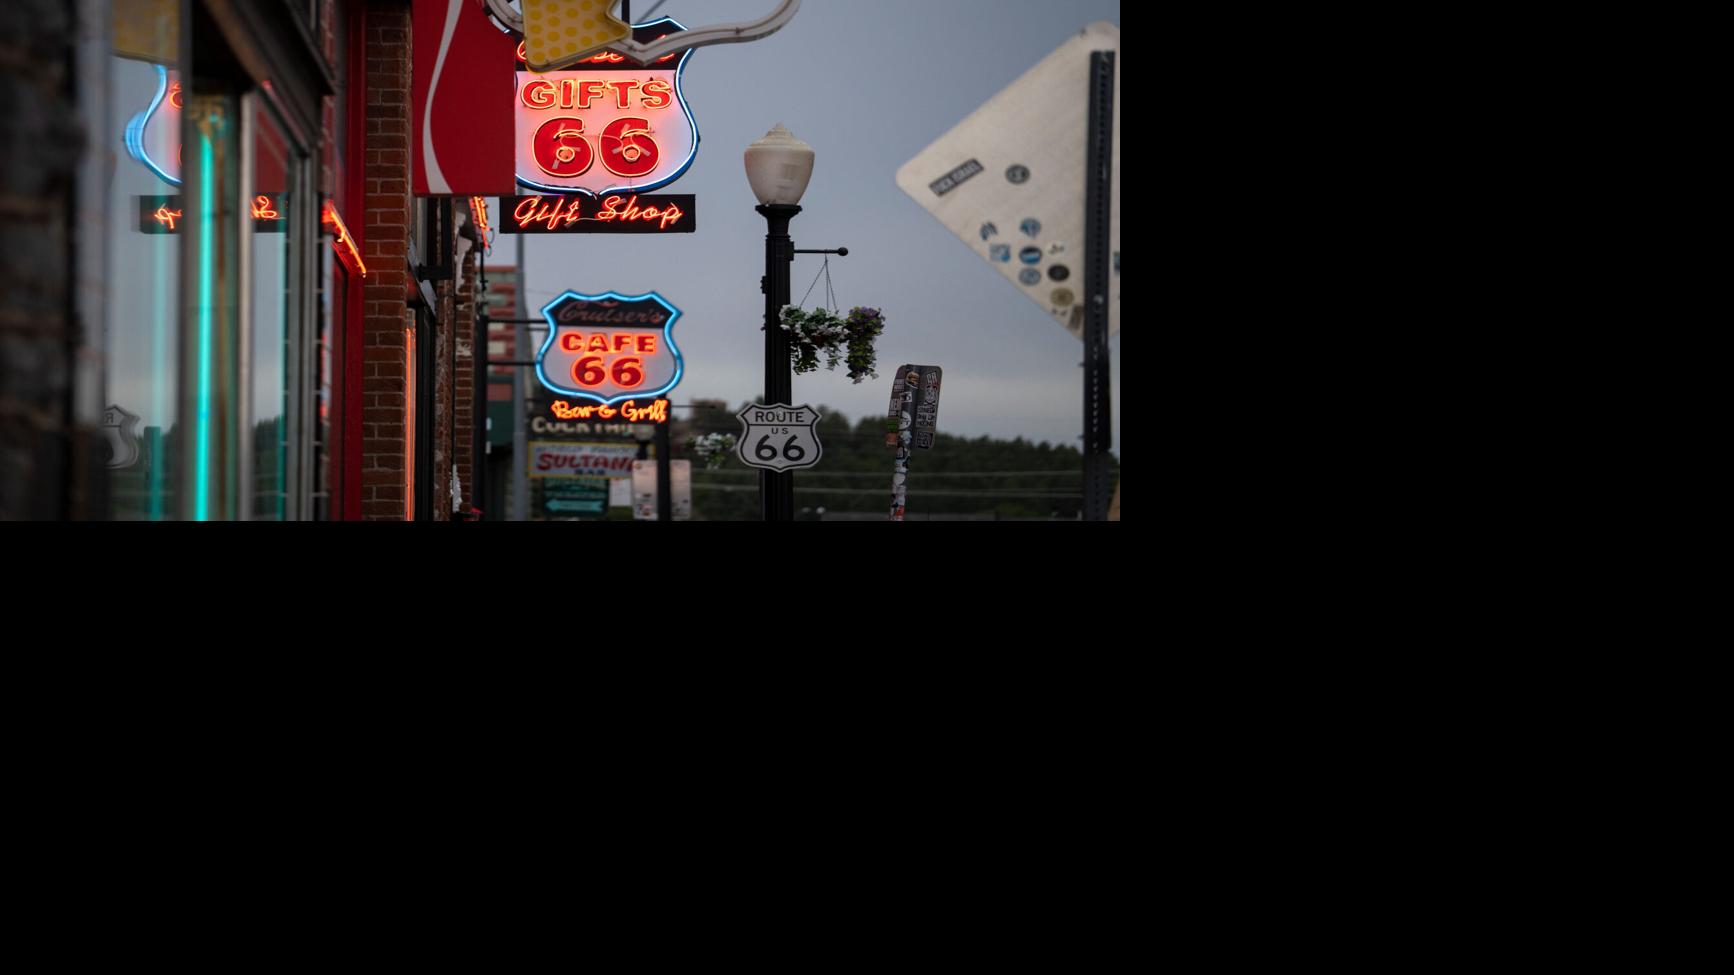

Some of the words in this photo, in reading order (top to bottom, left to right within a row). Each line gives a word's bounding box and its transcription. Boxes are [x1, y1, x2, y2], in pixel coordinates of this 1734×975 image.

[520, 80, 673, 109] GIFTS
[532, 116, 660, 177] 66
[514, 196, 580, 230] Gift
[598, 196, 682, 229] Shop
[559, 301, 665, 322] Cruiser's
[561, 333, 657, 354] CAFE
[570, 356, 647, 389] 66
[551, 400, 598, 420] Bar
[621, 400, 668, 422] Grill
[755, 411, 804, 423] ROUTE
[771, 427, 789, 435] US
[755, 434, 805, 461] 66
